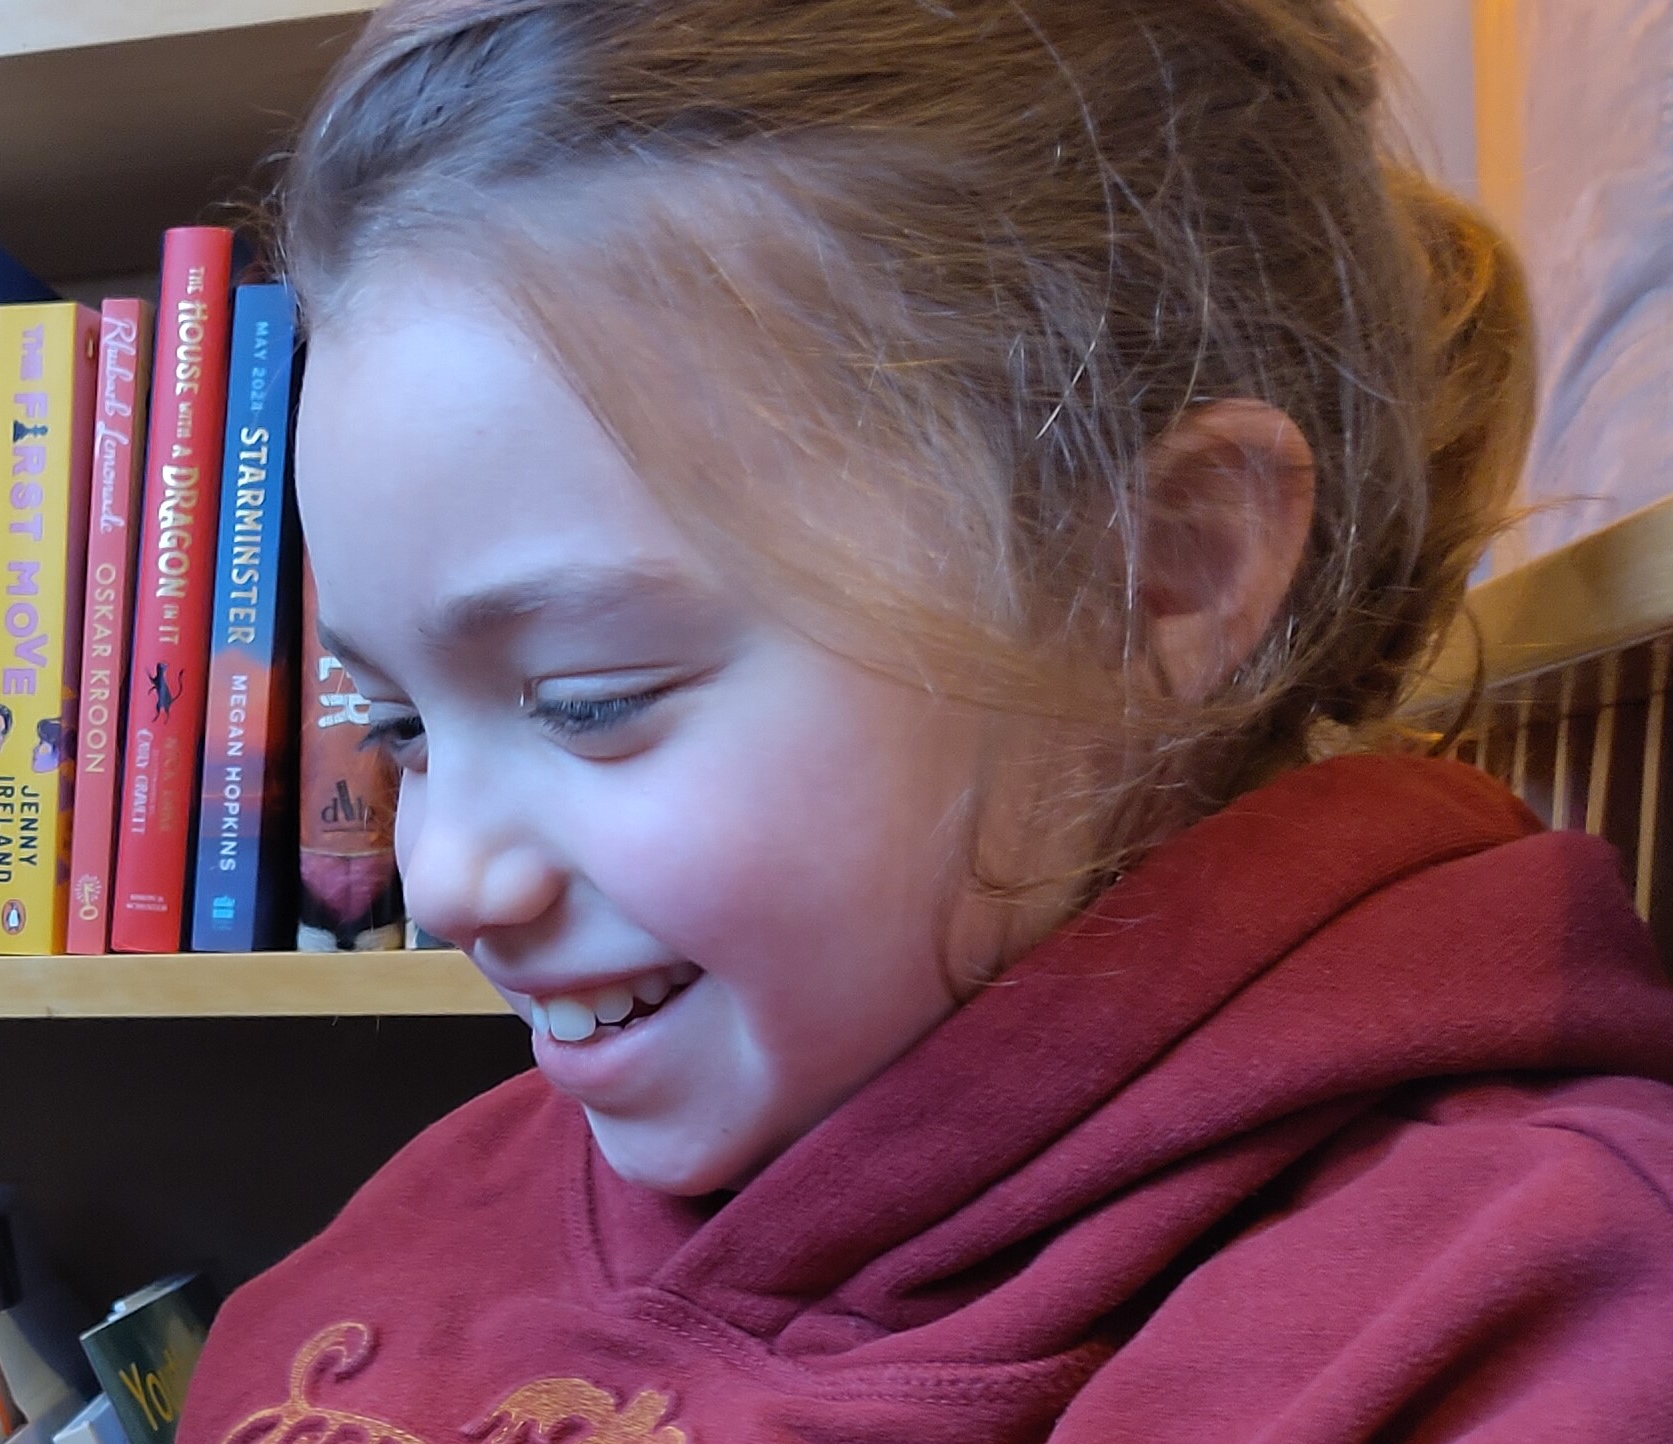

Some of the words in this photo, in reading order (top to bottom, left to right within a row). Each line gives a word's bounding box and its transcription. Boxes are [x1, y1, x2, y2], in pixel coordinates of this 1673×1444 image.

[20, 324, 46, 381] THE
[102, 317, 137, 418] Rhubarb
[175, 299, 209, 396] HOUSE
[255, 321, 270, 360] MAY
[94, 420, 129, 534] Lemonade
[155, 465, 201, 598] DRAGON
[227, 426, 270, 645] STARMINSTER
[2, 561, 49, 695] MOVE
[92, 563, 116, 657] OSKAR
[85, 670, 111, 774] KROON
[226, 675, 249, 756] MEGAN
[19, 784, 40, 866] JENNY
[219, 766, 243, 872] HOPKINS
